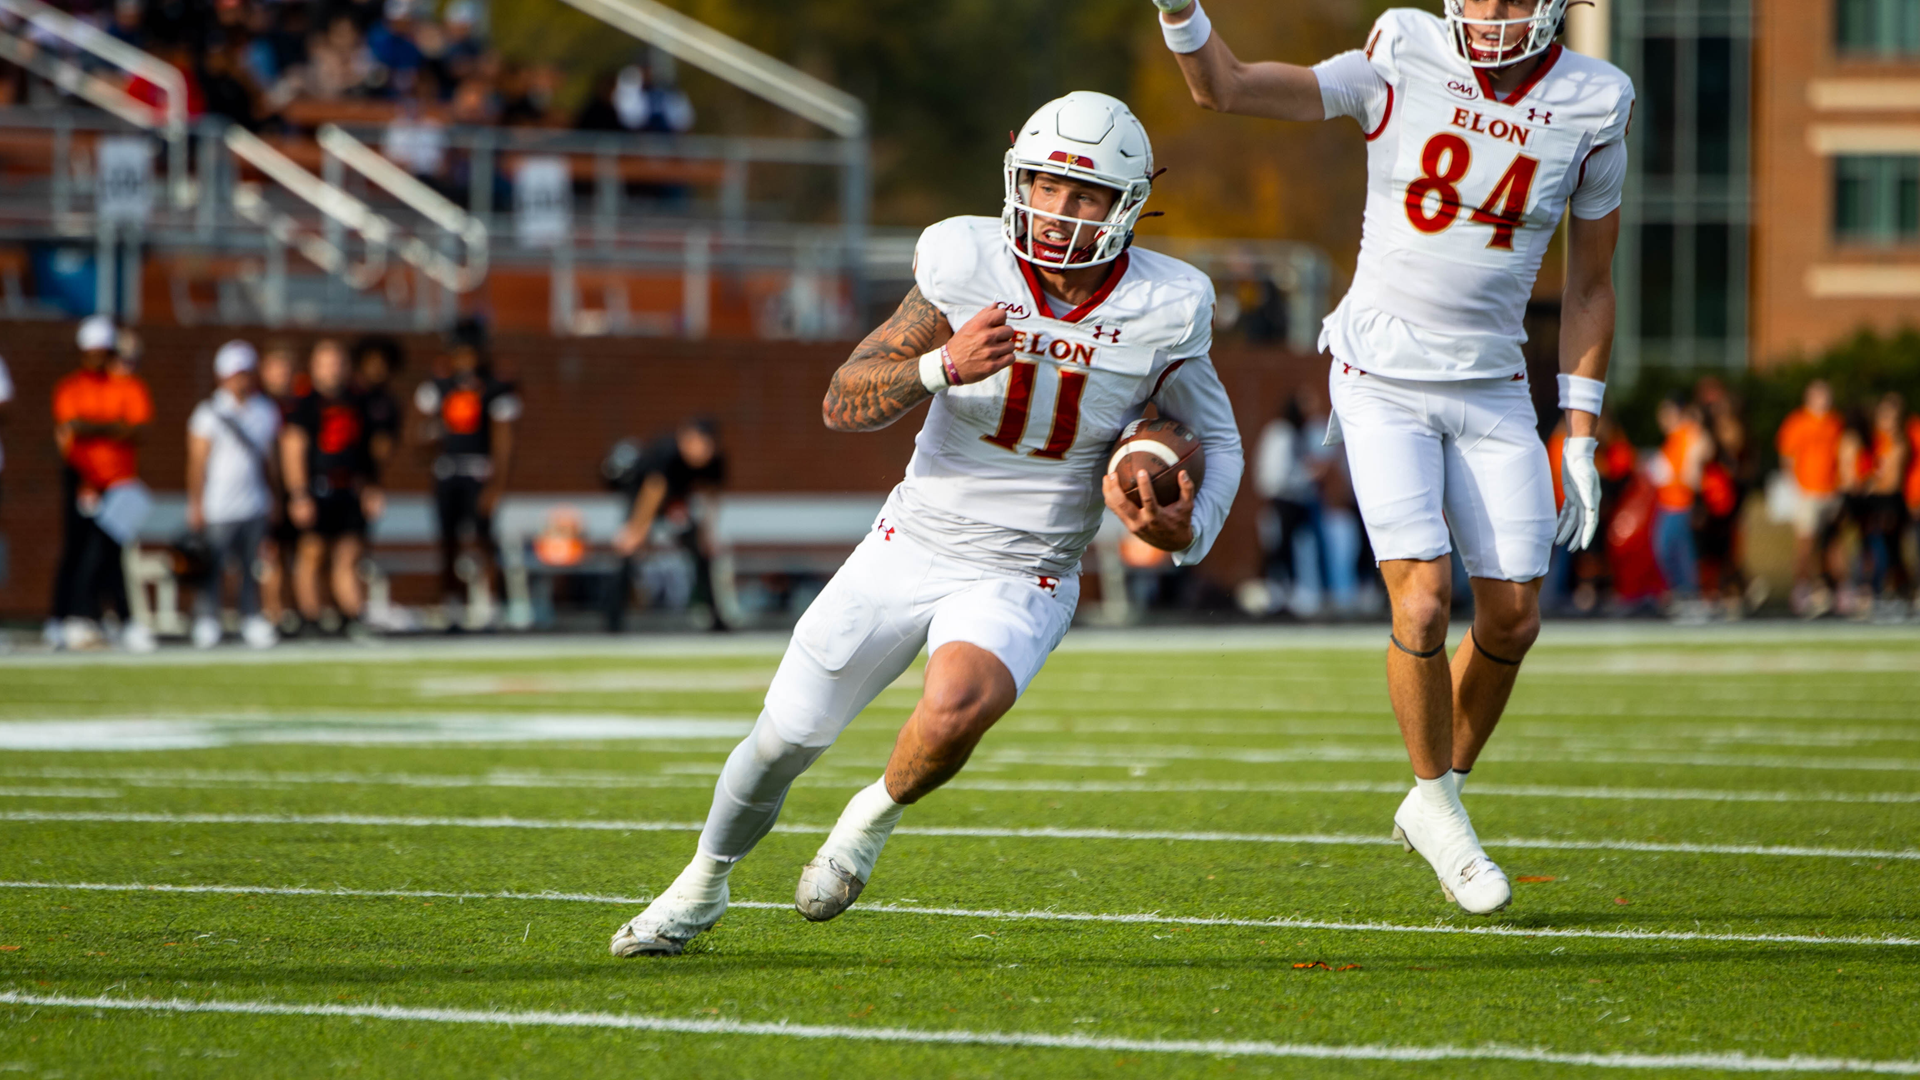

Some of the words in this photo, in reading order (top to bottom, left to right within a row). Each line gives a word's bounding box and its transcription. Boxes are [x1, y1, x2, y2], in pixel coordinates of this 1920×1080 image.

[1451, 106, 1530, 147] ELON
[1404, 132, 1541, 250] 84
[1010, 329, 1096, 367] ELON
[979, 359, 1089, 460] 11
